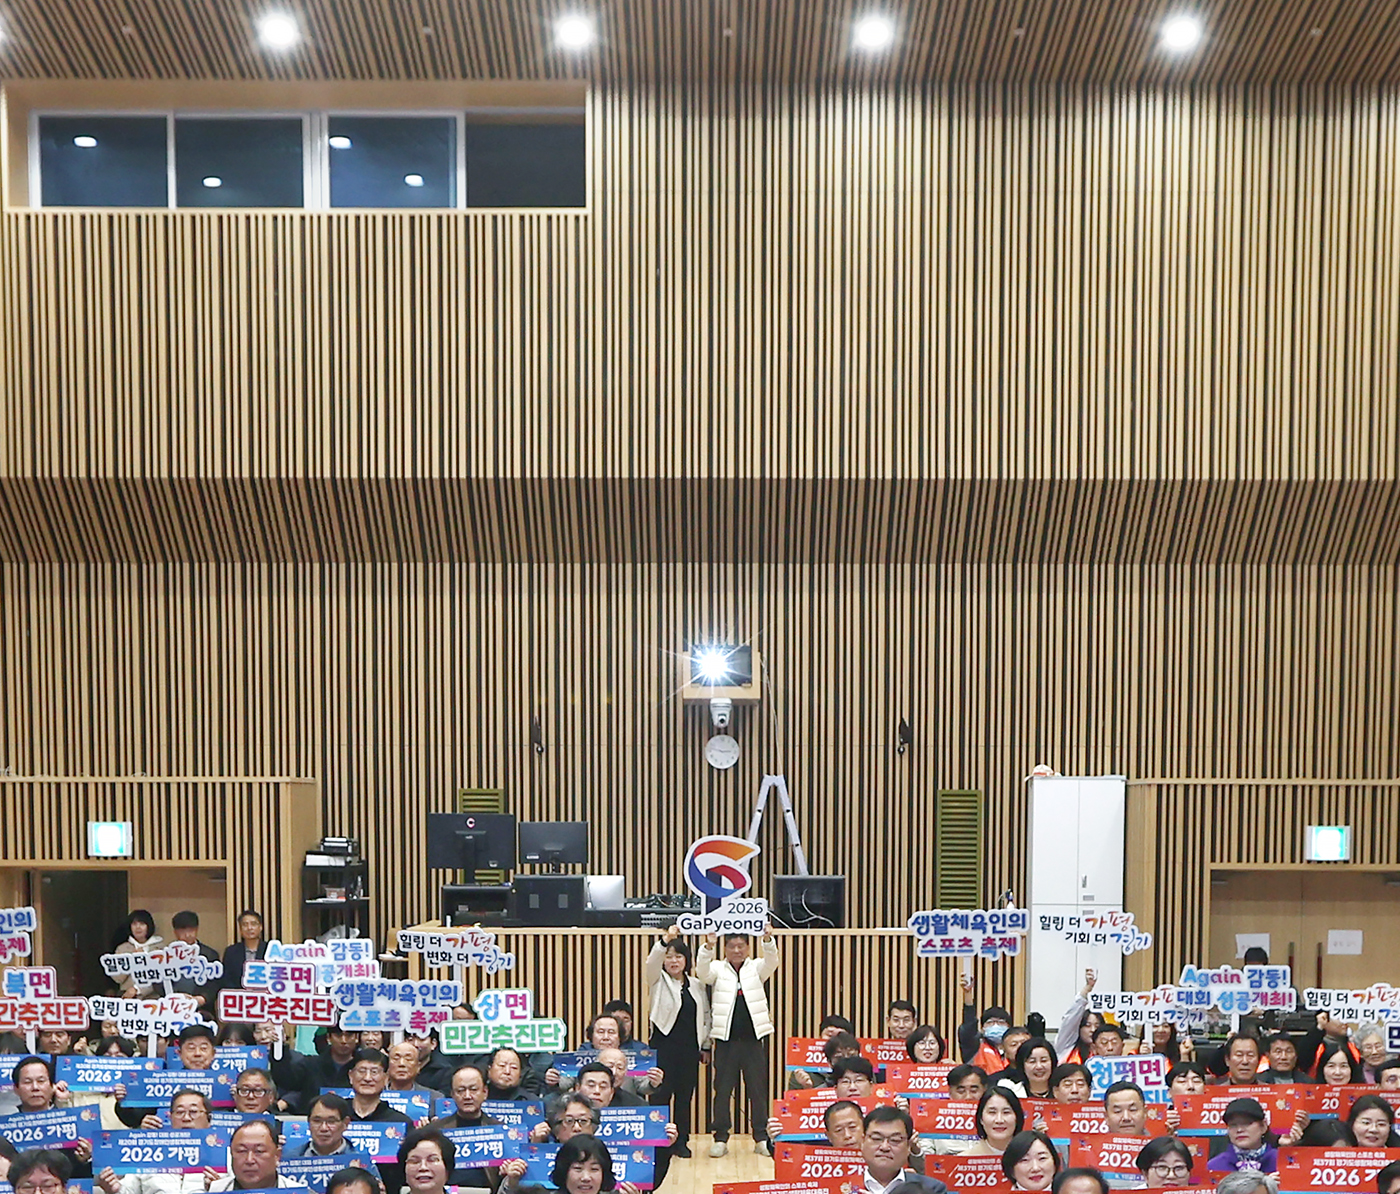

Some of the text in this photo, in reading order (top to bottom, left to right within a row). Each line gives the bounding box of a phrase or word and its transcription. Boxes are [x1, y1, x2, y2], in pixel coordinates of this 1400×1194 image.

[727, 902, 763, 916] 2026
[680, 916, 764, 935] GaPyeong
[911, 912, 1026, 937] 생활체육인의
[1039, 911, 1132, 932] 힐링 더 가평
[269, 942, 370, 962] Again 감동!
[400, 932, 494, 952] 힐링 더 가평
[920, 936, 1017, 958] 스포츠 축제
[1065, 931, 1150, 952] 기회 더 경기
[104, 945, 198, 974] 힐링 더 가평
[426, 949, 511, 972] 변화 더 경기
[5, 971, 51, 998] 북면
[134, 963, 220, 985] 변화 더 경기
[246, 964, 312, 994] 조종면
[1184, 968, 1287, 988] Again 감동!
[335, 982, 459, 1008] 생활체육인의
[1091, 993, 1116, 1009] 힐링
[1121, 994, 1133, 1008] 더
[1177, 989, 1292, 1013] 대회 성공개최!
[1307, 990, 1332, 1006] 힐링
[1337, 992, 1348, 1005] 더
[1356, 985, 1400, 1007] 가평
[93, 997, 195, 1017] 힐링 더 가평
[222, 996, 334, 1022] 민간추진단
[478, 993, 528, 1021] 상면
[1117, 1009, 1143, 1023] 기회
[1148, 1009, 1160, 1022] 더
[1333, 1006, 1358, 1021] 기회
[1363, 1007, 1375, 1020] 더
[121, 1020, 150, 1037] 변화
[154, 1020, 168, 1035] 더
[343, 1010, 448, 1034] 스포츠 축제
[445, 1024, 562, 1048] 민간추진단
[1091, 1060, 1162, 1088] 청평면
[2, 1123, 77, 1143] 2026 가평
[121, 1146, 200, 1167] 2026 가평
[1310, 1168, 1360, 1186] 2026
